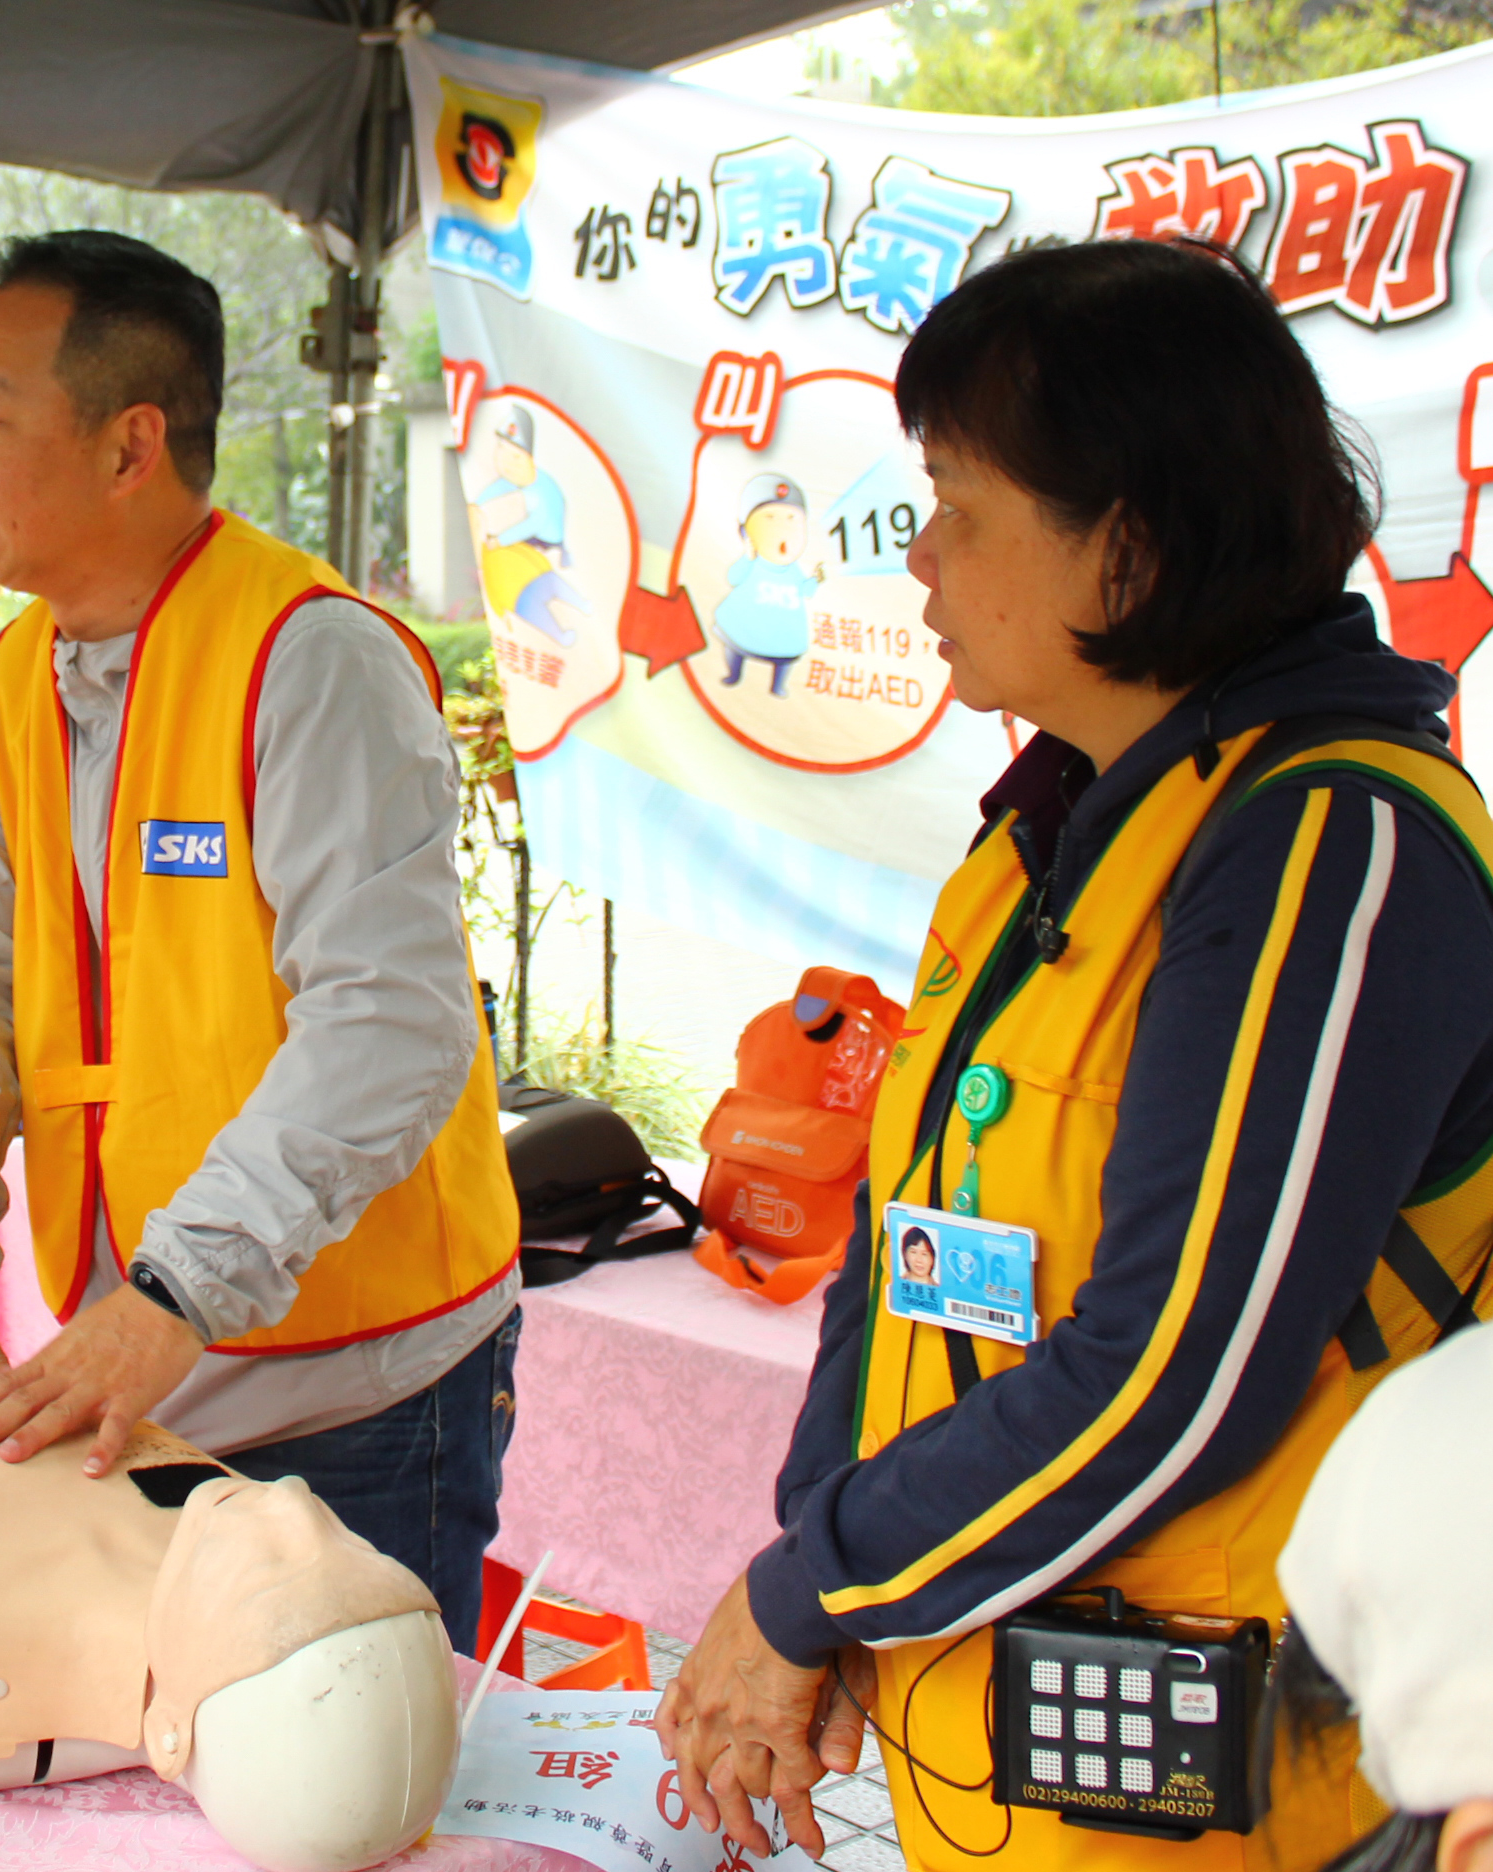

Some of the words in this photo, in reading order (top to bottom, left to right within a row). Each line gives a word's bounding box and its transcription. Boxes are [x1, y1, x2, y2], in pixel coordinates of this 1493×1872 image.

[694, 350, 784, 452] 叫
[828, 502, 918, 564] 119
[805, 657, 925, 710] 取出AED
[153, 834, 223, 865] SKS
[728, 1188, 805, 1238] AED
[1137, 1799, 1216, 1818] 29405207
